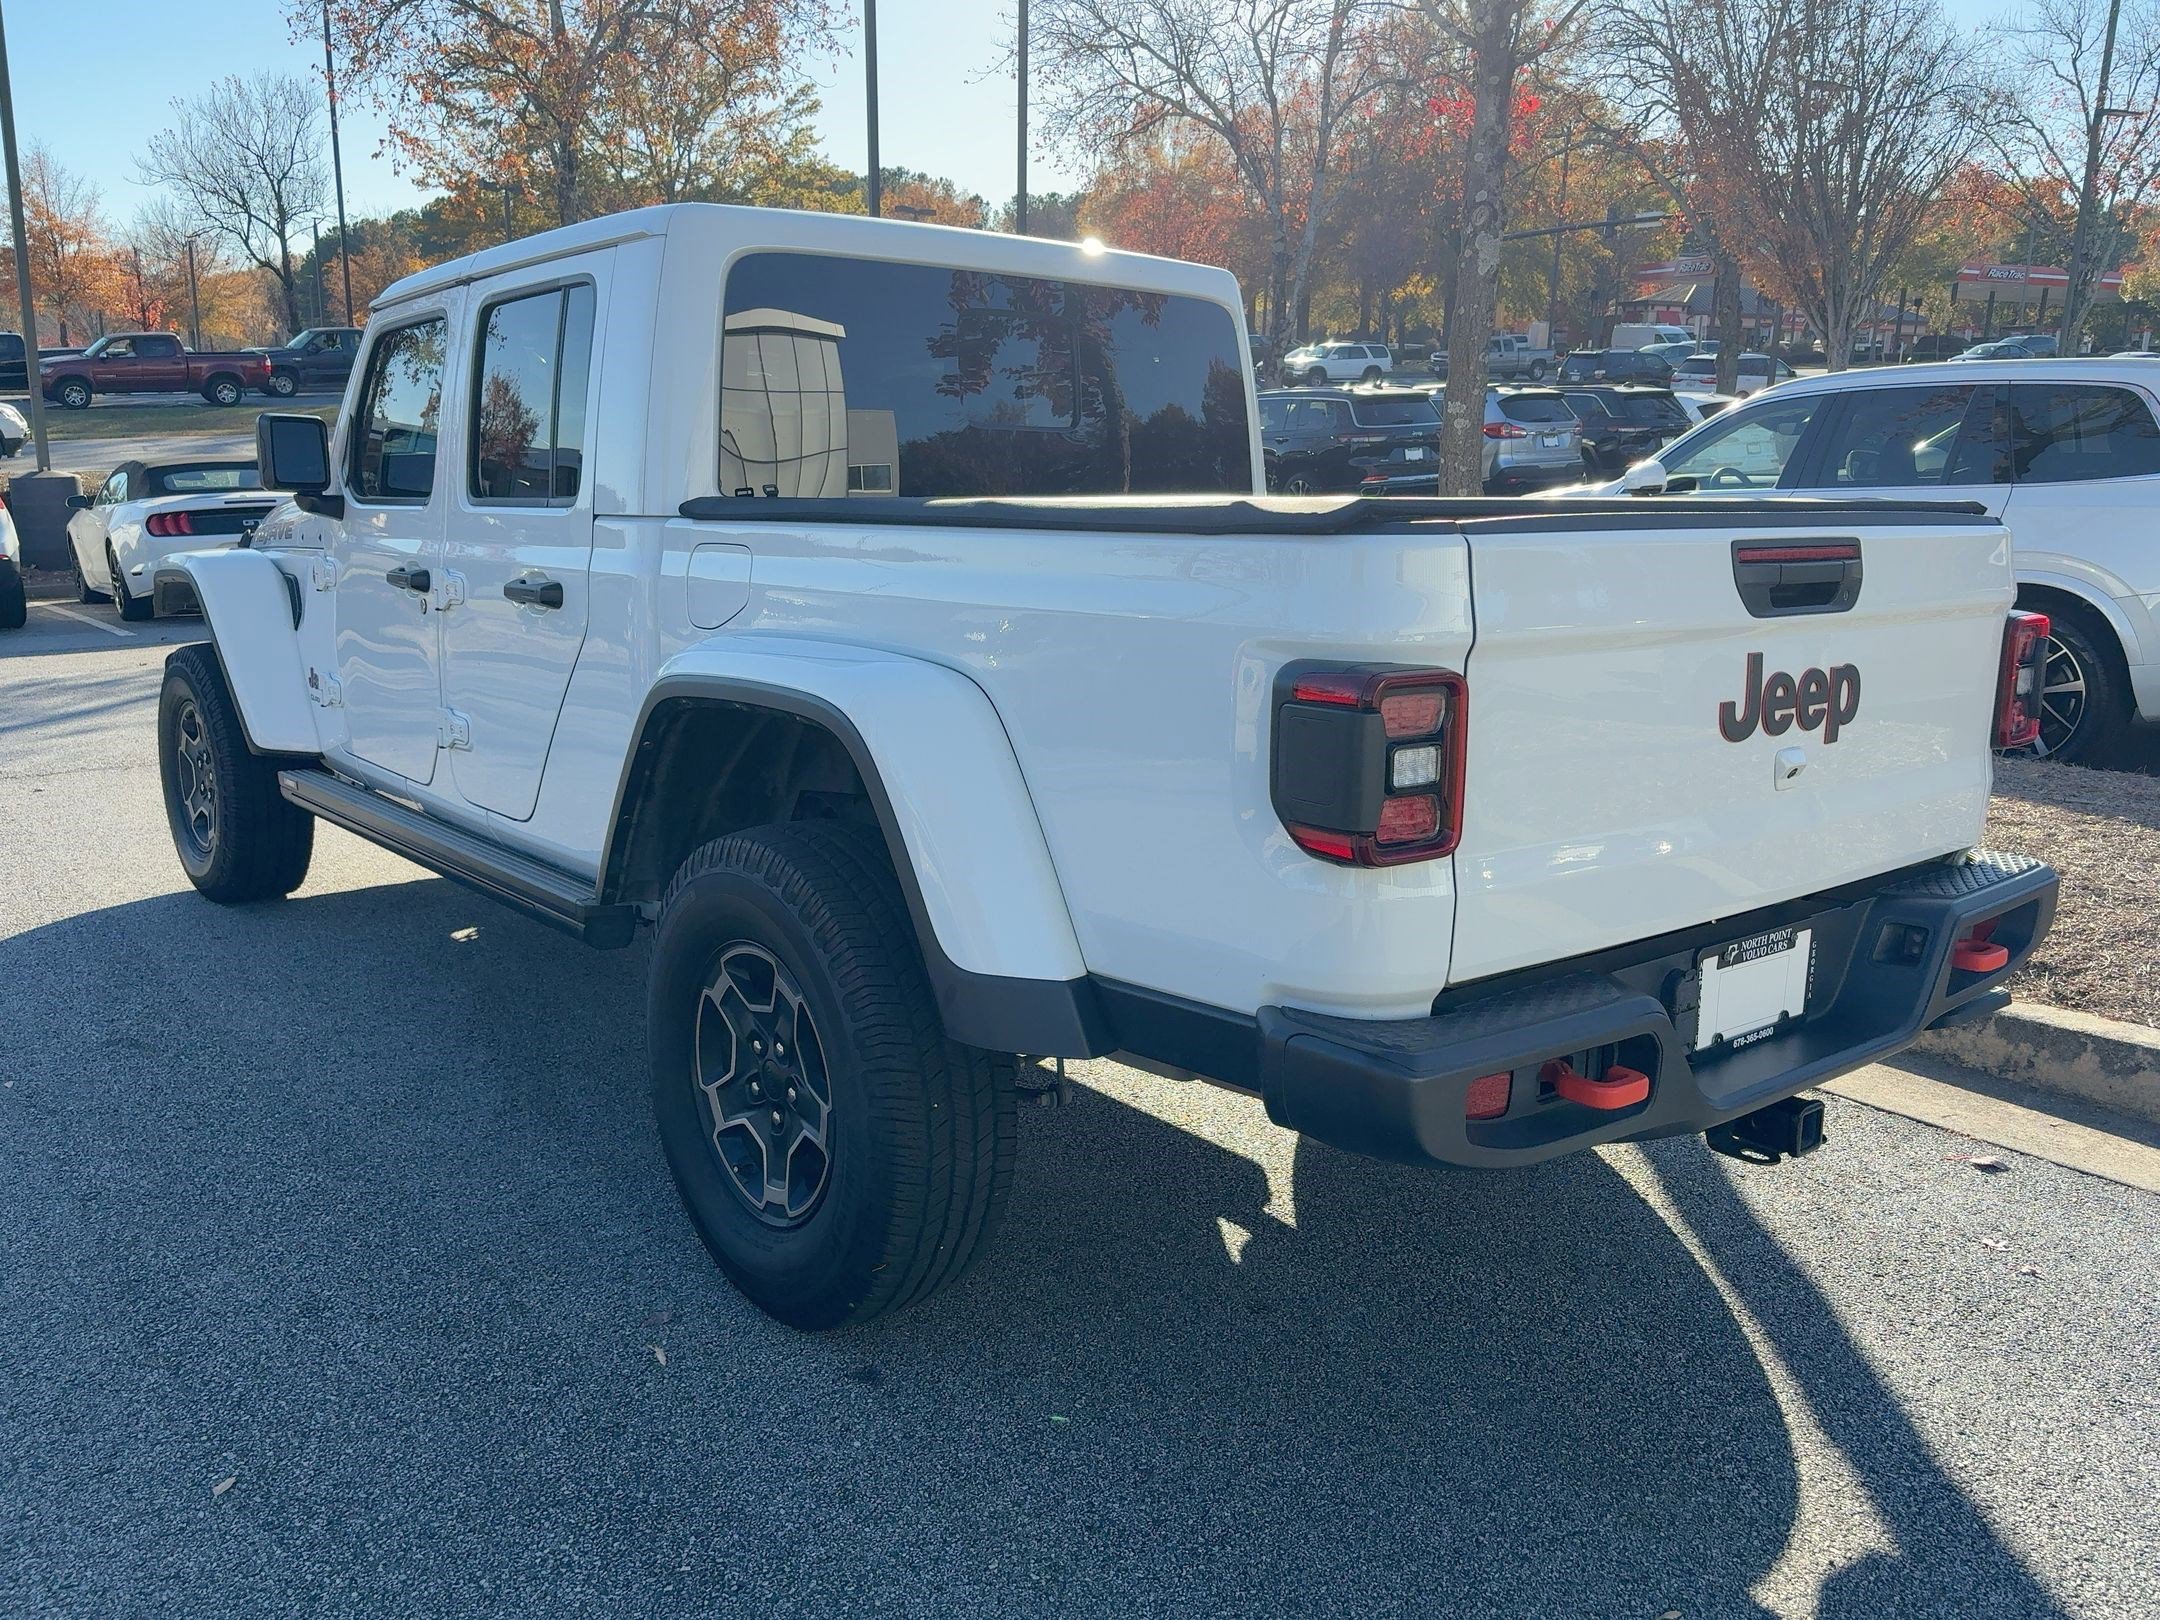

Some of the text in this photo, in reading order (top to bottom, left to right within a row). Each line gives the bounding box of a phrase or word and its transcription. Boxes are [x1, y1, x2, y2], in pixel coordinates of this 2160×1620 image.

[1987, 268, 2026, 279] RaceTrac
[1719, 652, 1861, 744] Jeep
[1741, 928, 1792, 951] NORTH POINT
[1742, 940, 1788, 961] VOLVO CARS
[1807, 941, 1817, 999] GEORGIA
